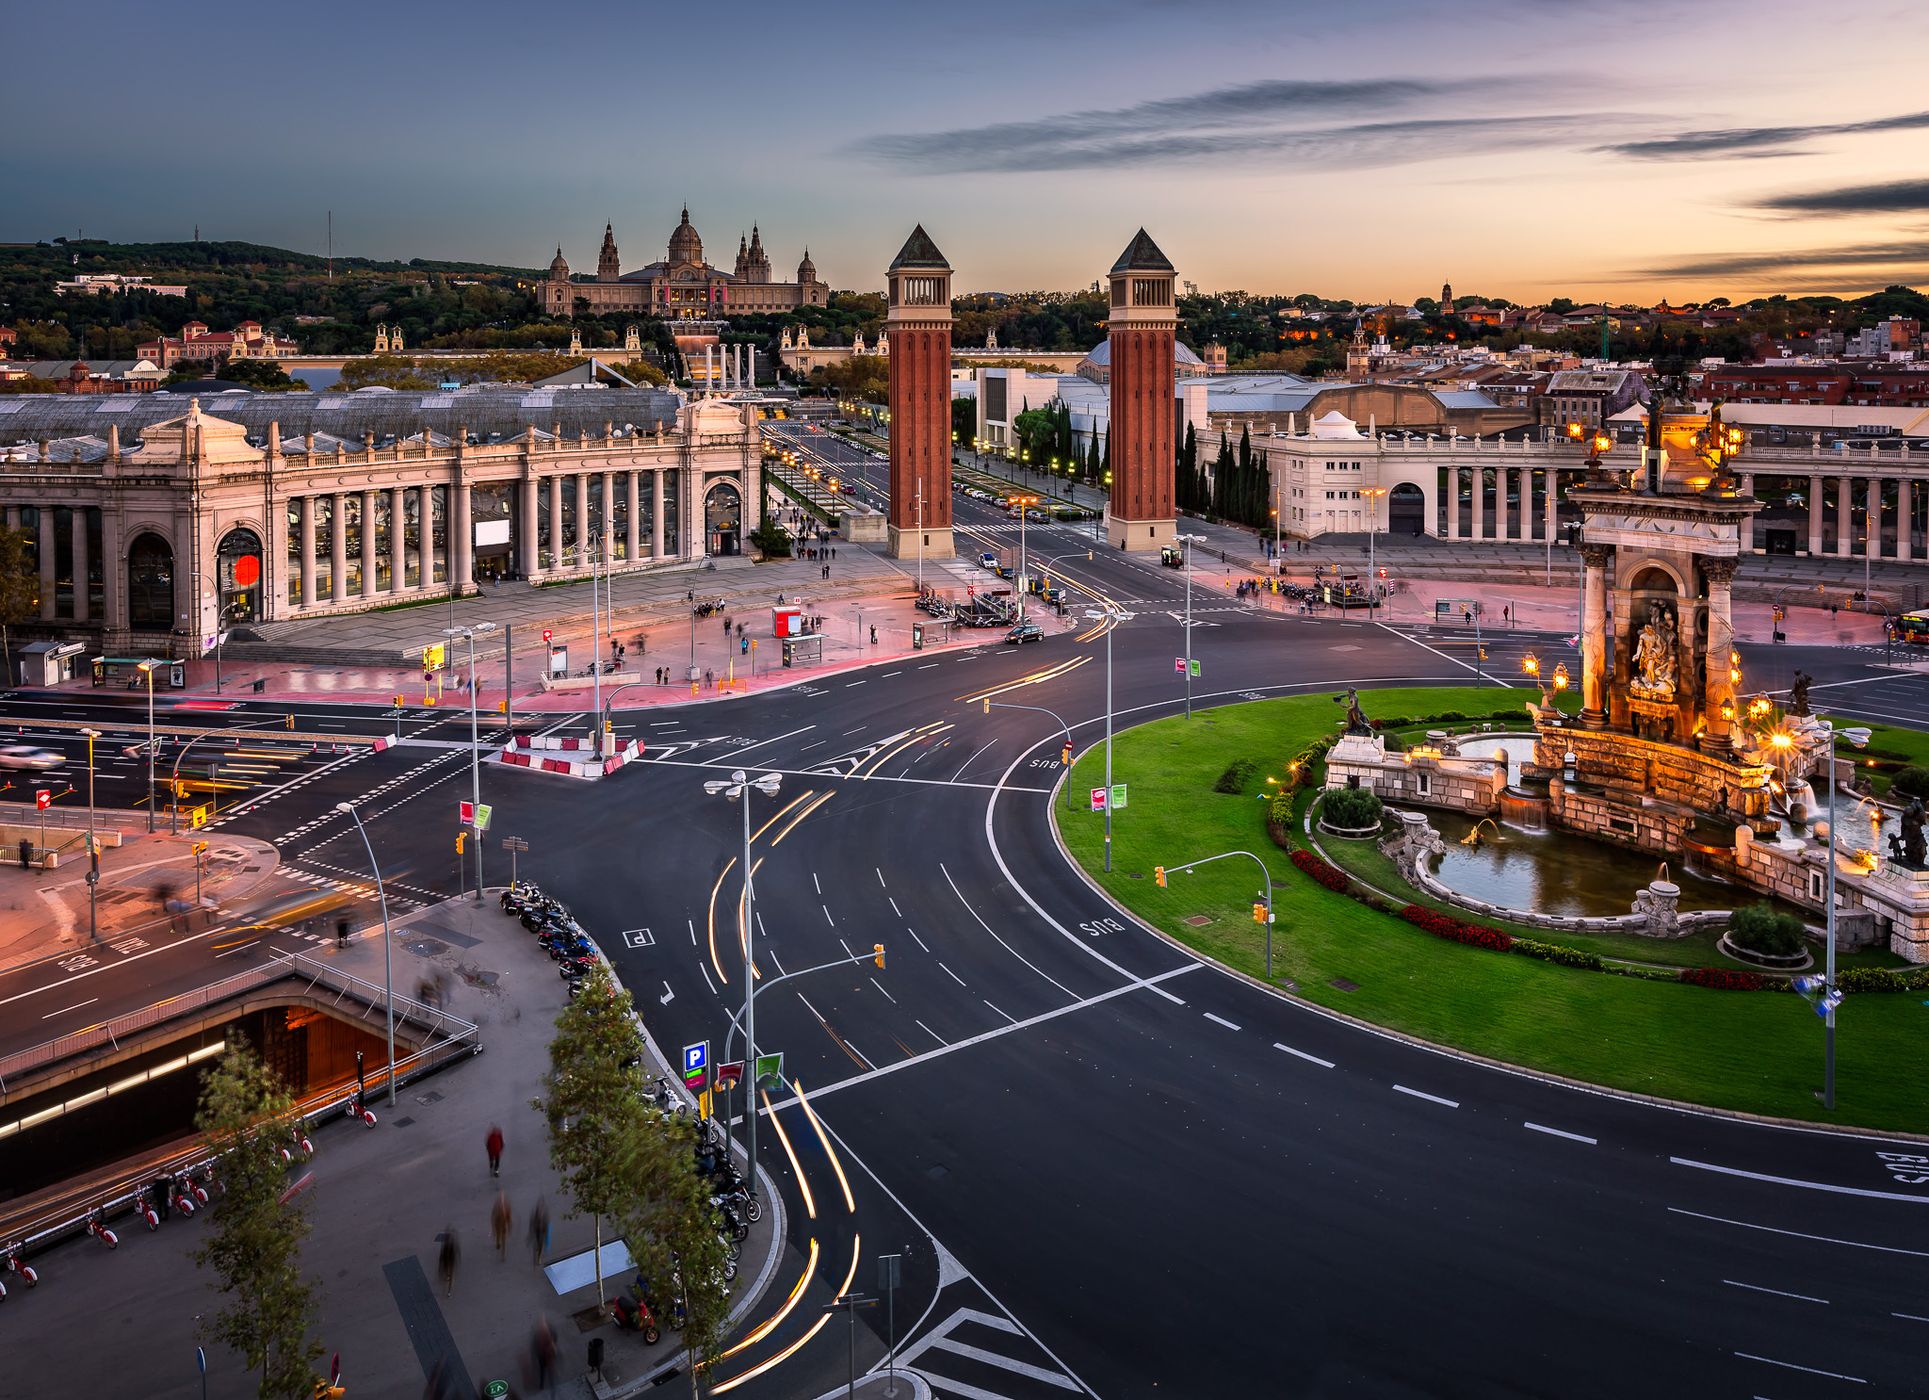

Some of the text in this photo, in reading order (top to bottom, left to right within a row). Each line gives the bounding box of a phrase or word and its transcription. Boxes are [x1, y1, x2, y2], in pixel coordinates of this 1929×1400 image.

[1029, 759, 1060, 769] BUS
[1079, 917, 1126, 936] BUS
[633, 931, 647, 944] P
[57, 954, 99, 972] BUS
[689, 1049, 702, 1066] P
[1875, 1151, 1929, 1183] BUS
